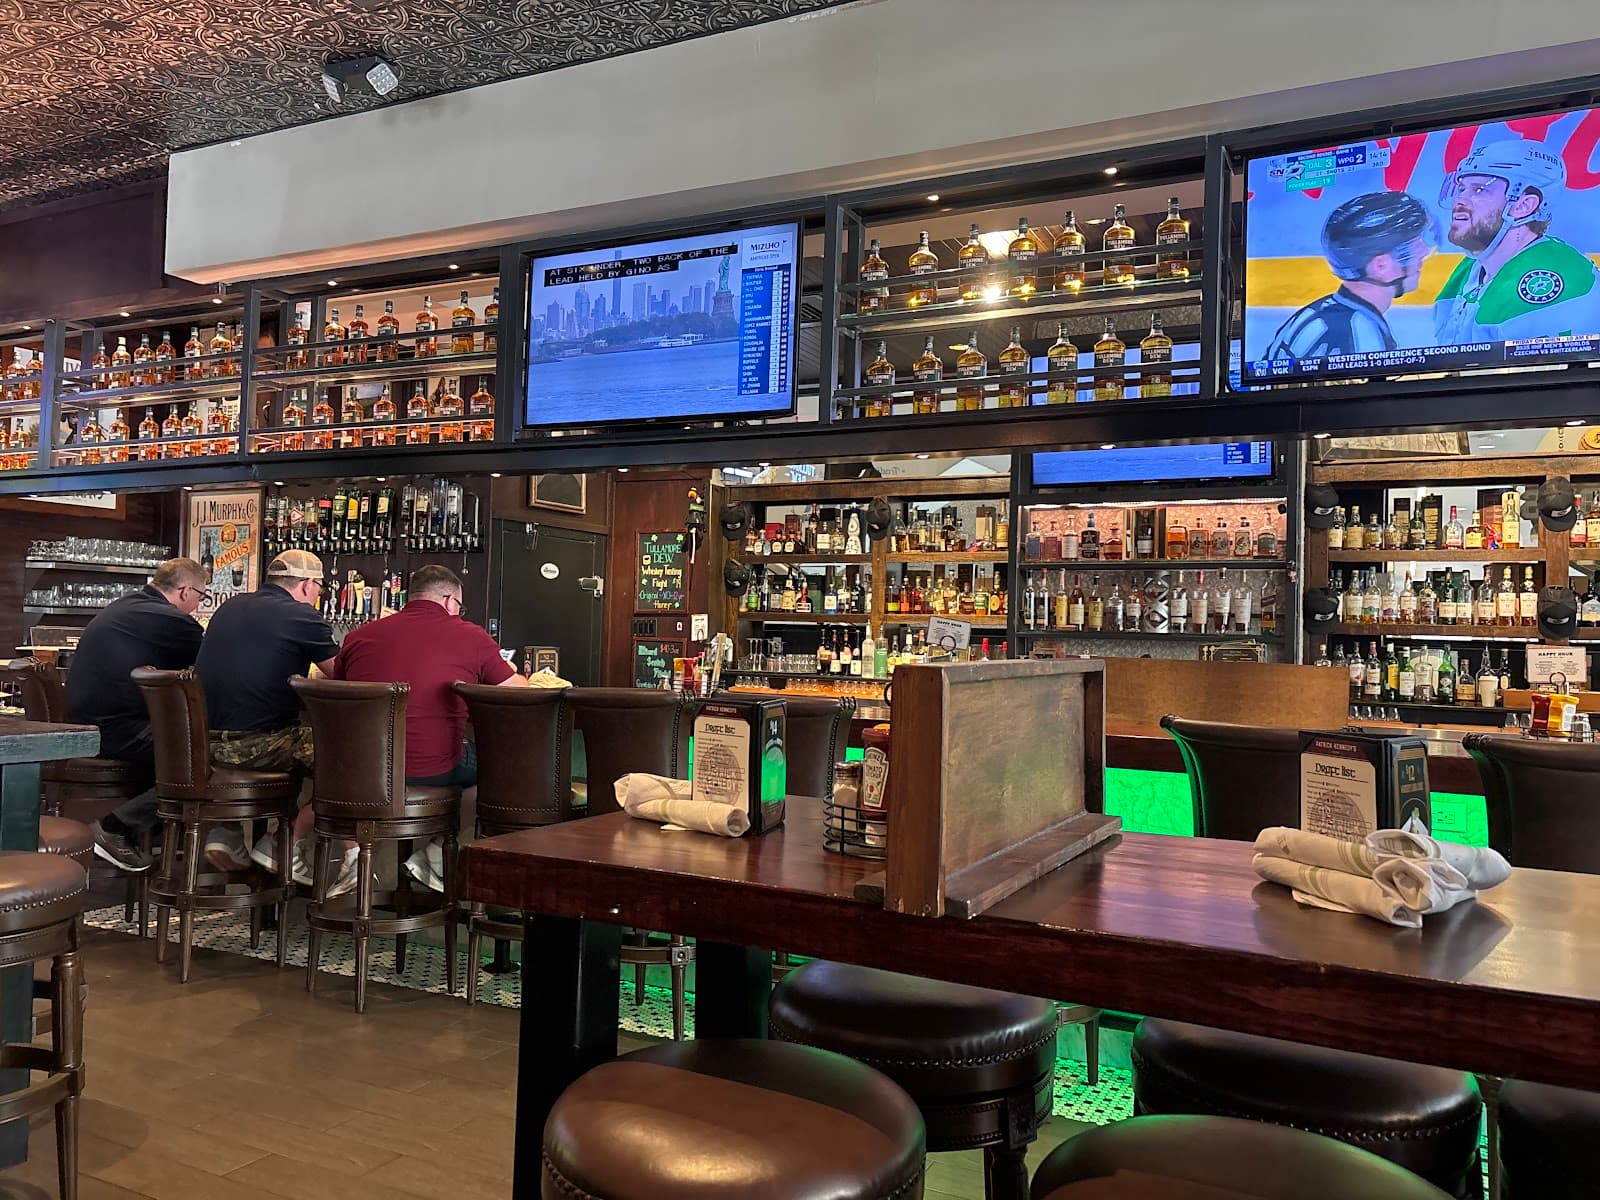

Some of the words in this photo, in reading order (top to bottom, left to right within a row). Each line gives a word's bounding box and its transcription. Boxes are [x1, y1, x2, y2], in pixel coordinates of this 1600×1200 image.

[1326, 158, 1332, 168] 3
[1338, 156, 1354, 164] WPG
[1356, 154, 1363, 163] 2
[751, 242, 779, 251] MIZUHO
[566, 266, 585, 275] SIX
[634, 257, 652, 265] TWO
[658, 253, 683, 262] BACK
[688, 250, 702, 258] OF
[709, 247, 729, 255] THE
[550, 276, 574, 285] LEAD
[579, 272, 603, 282] HELD
[608, 270, 619, 278] BY
[625, 266, 652, 276] GINO
[1328, 353, 1366, 363] WESTERN
[1369, 349, 1422, 360] CONFERENCE
[1424, 346, 1459, 355] SECOND
[1461, 344, 1491, 353] ROUND
[1383, 357, 1426, 367] (BEST-OF-7)
[209, 500, 242, 522] MURPHY
[644, 542, 682, 554] TULLAMORE
[215, 542, 249, 569] FAMOUS
[653, 553, 674, 564] DEW
[705, 723, 723, 733] Draft
[1316, 740, 1333, 749] PATRICK
[1334, 742, 1357, 752] KENNEDY'S
[1316, 763, 1340, 776] Draft
